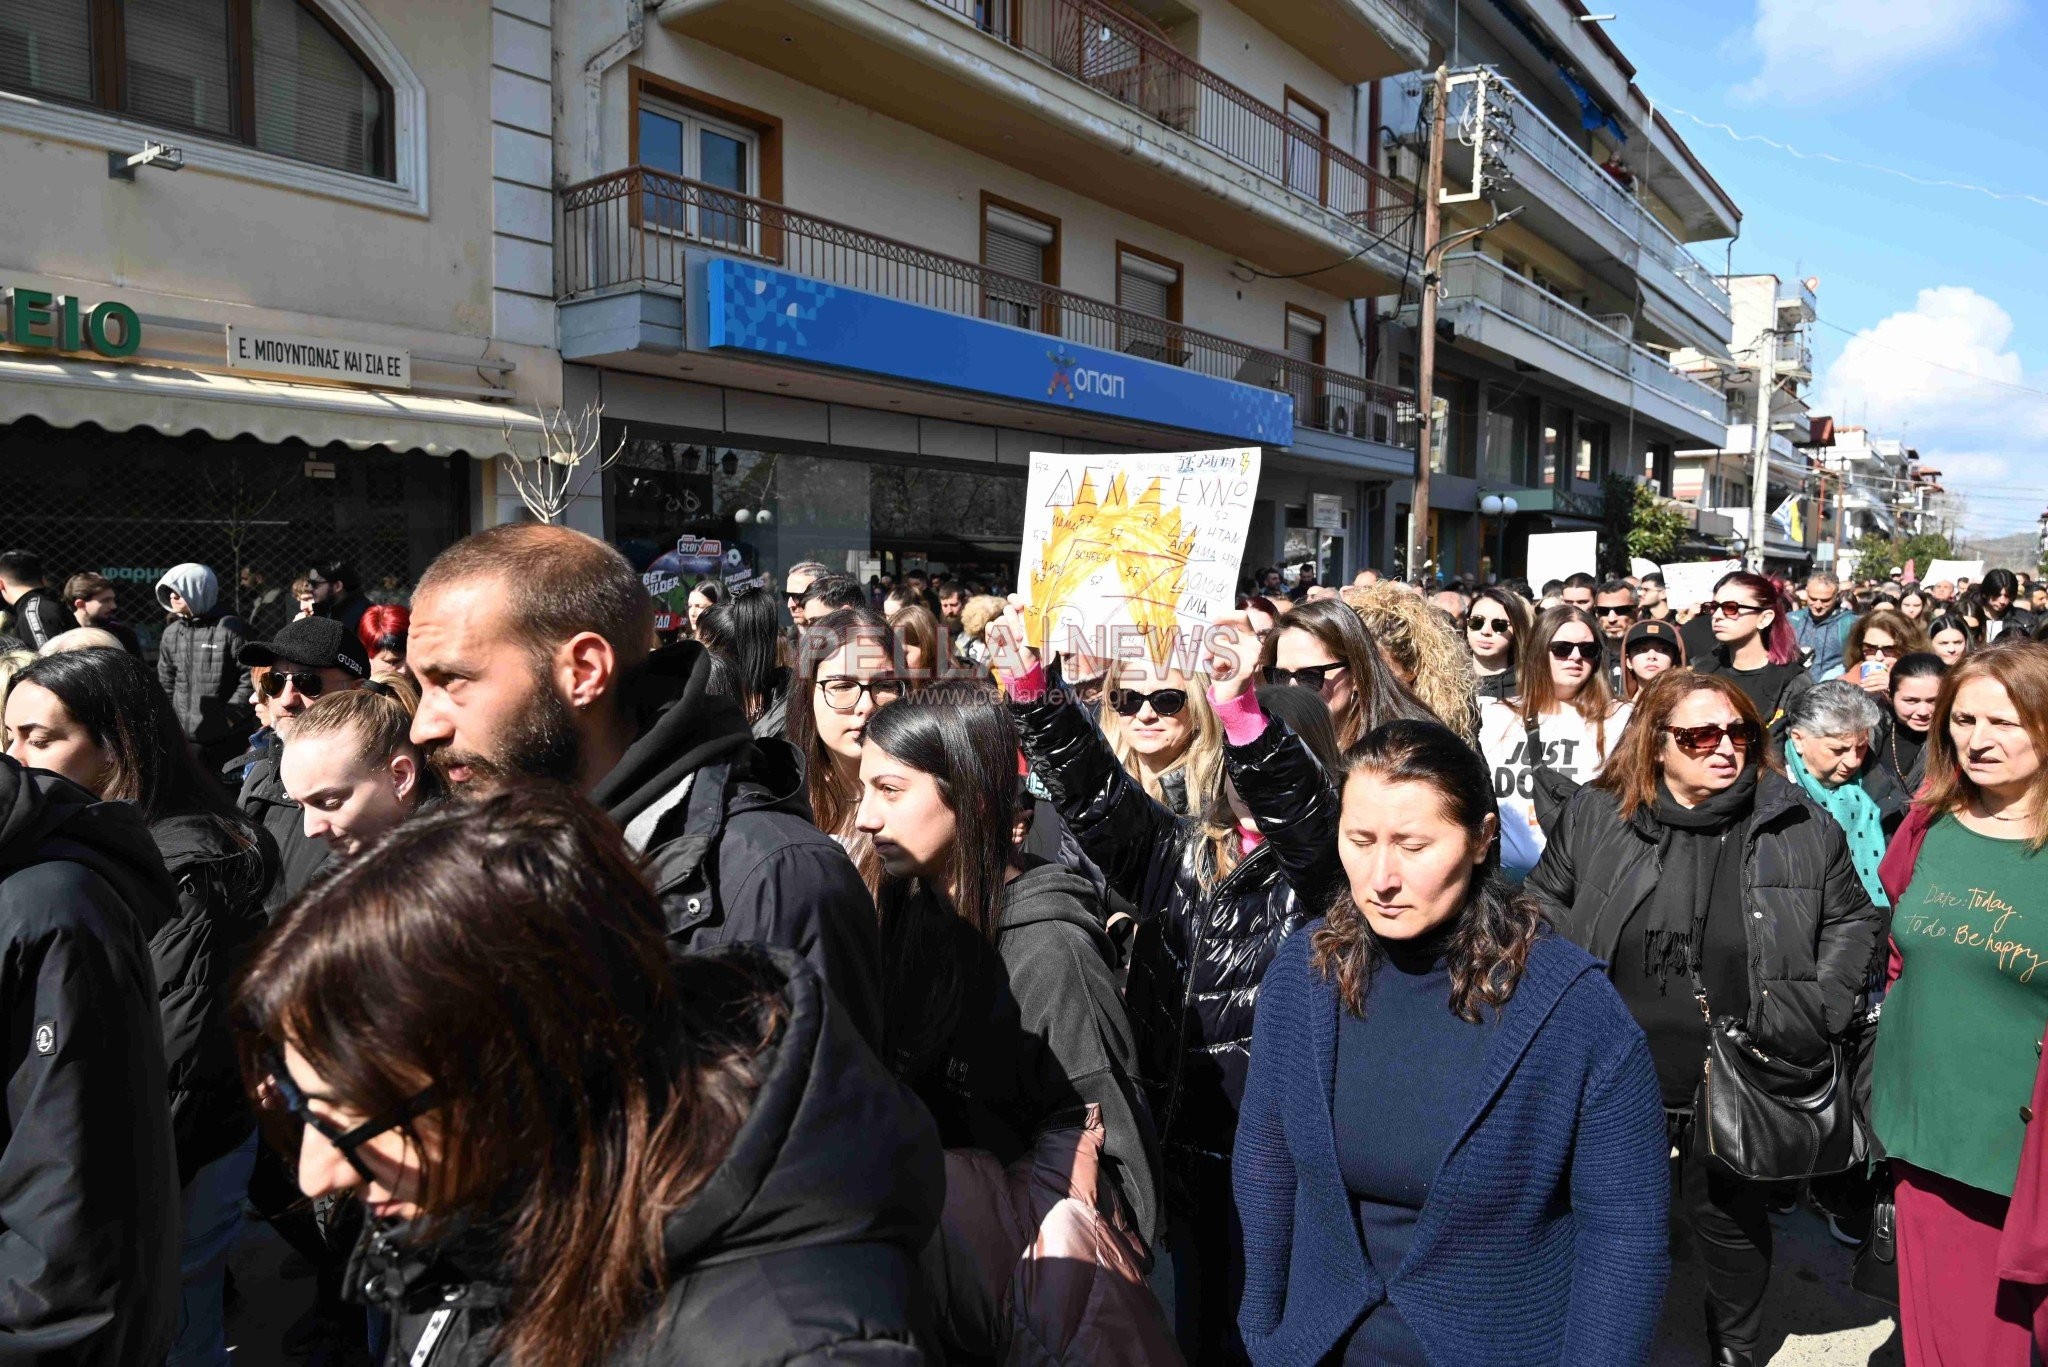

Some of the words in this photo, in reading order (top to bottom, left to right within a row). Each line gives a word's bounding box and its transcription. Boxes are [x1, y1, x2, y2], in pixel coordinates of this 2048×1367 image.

[0, 285, 141, 358] ΕΙΟ
[239, 337, 250, 359] Ε.
[254, 339, 340, 370] ΜΠΟΥΝΤΩΝΑΣ
[344, 351, 362, 372] ΚΑΙ
[365, 353, 384, 375] ΣΙΑ
[387, 356, 401, 377] ΕΕ
[1045, 466, 1130, 507] ΔΕΝ
[1167, 519, 1201, 540] ΔΕΝ
[648, 577, 681, 597] ILDER
[1954, 924, 1985, 946] Be
[1985, 933, 2048, 983] happy
